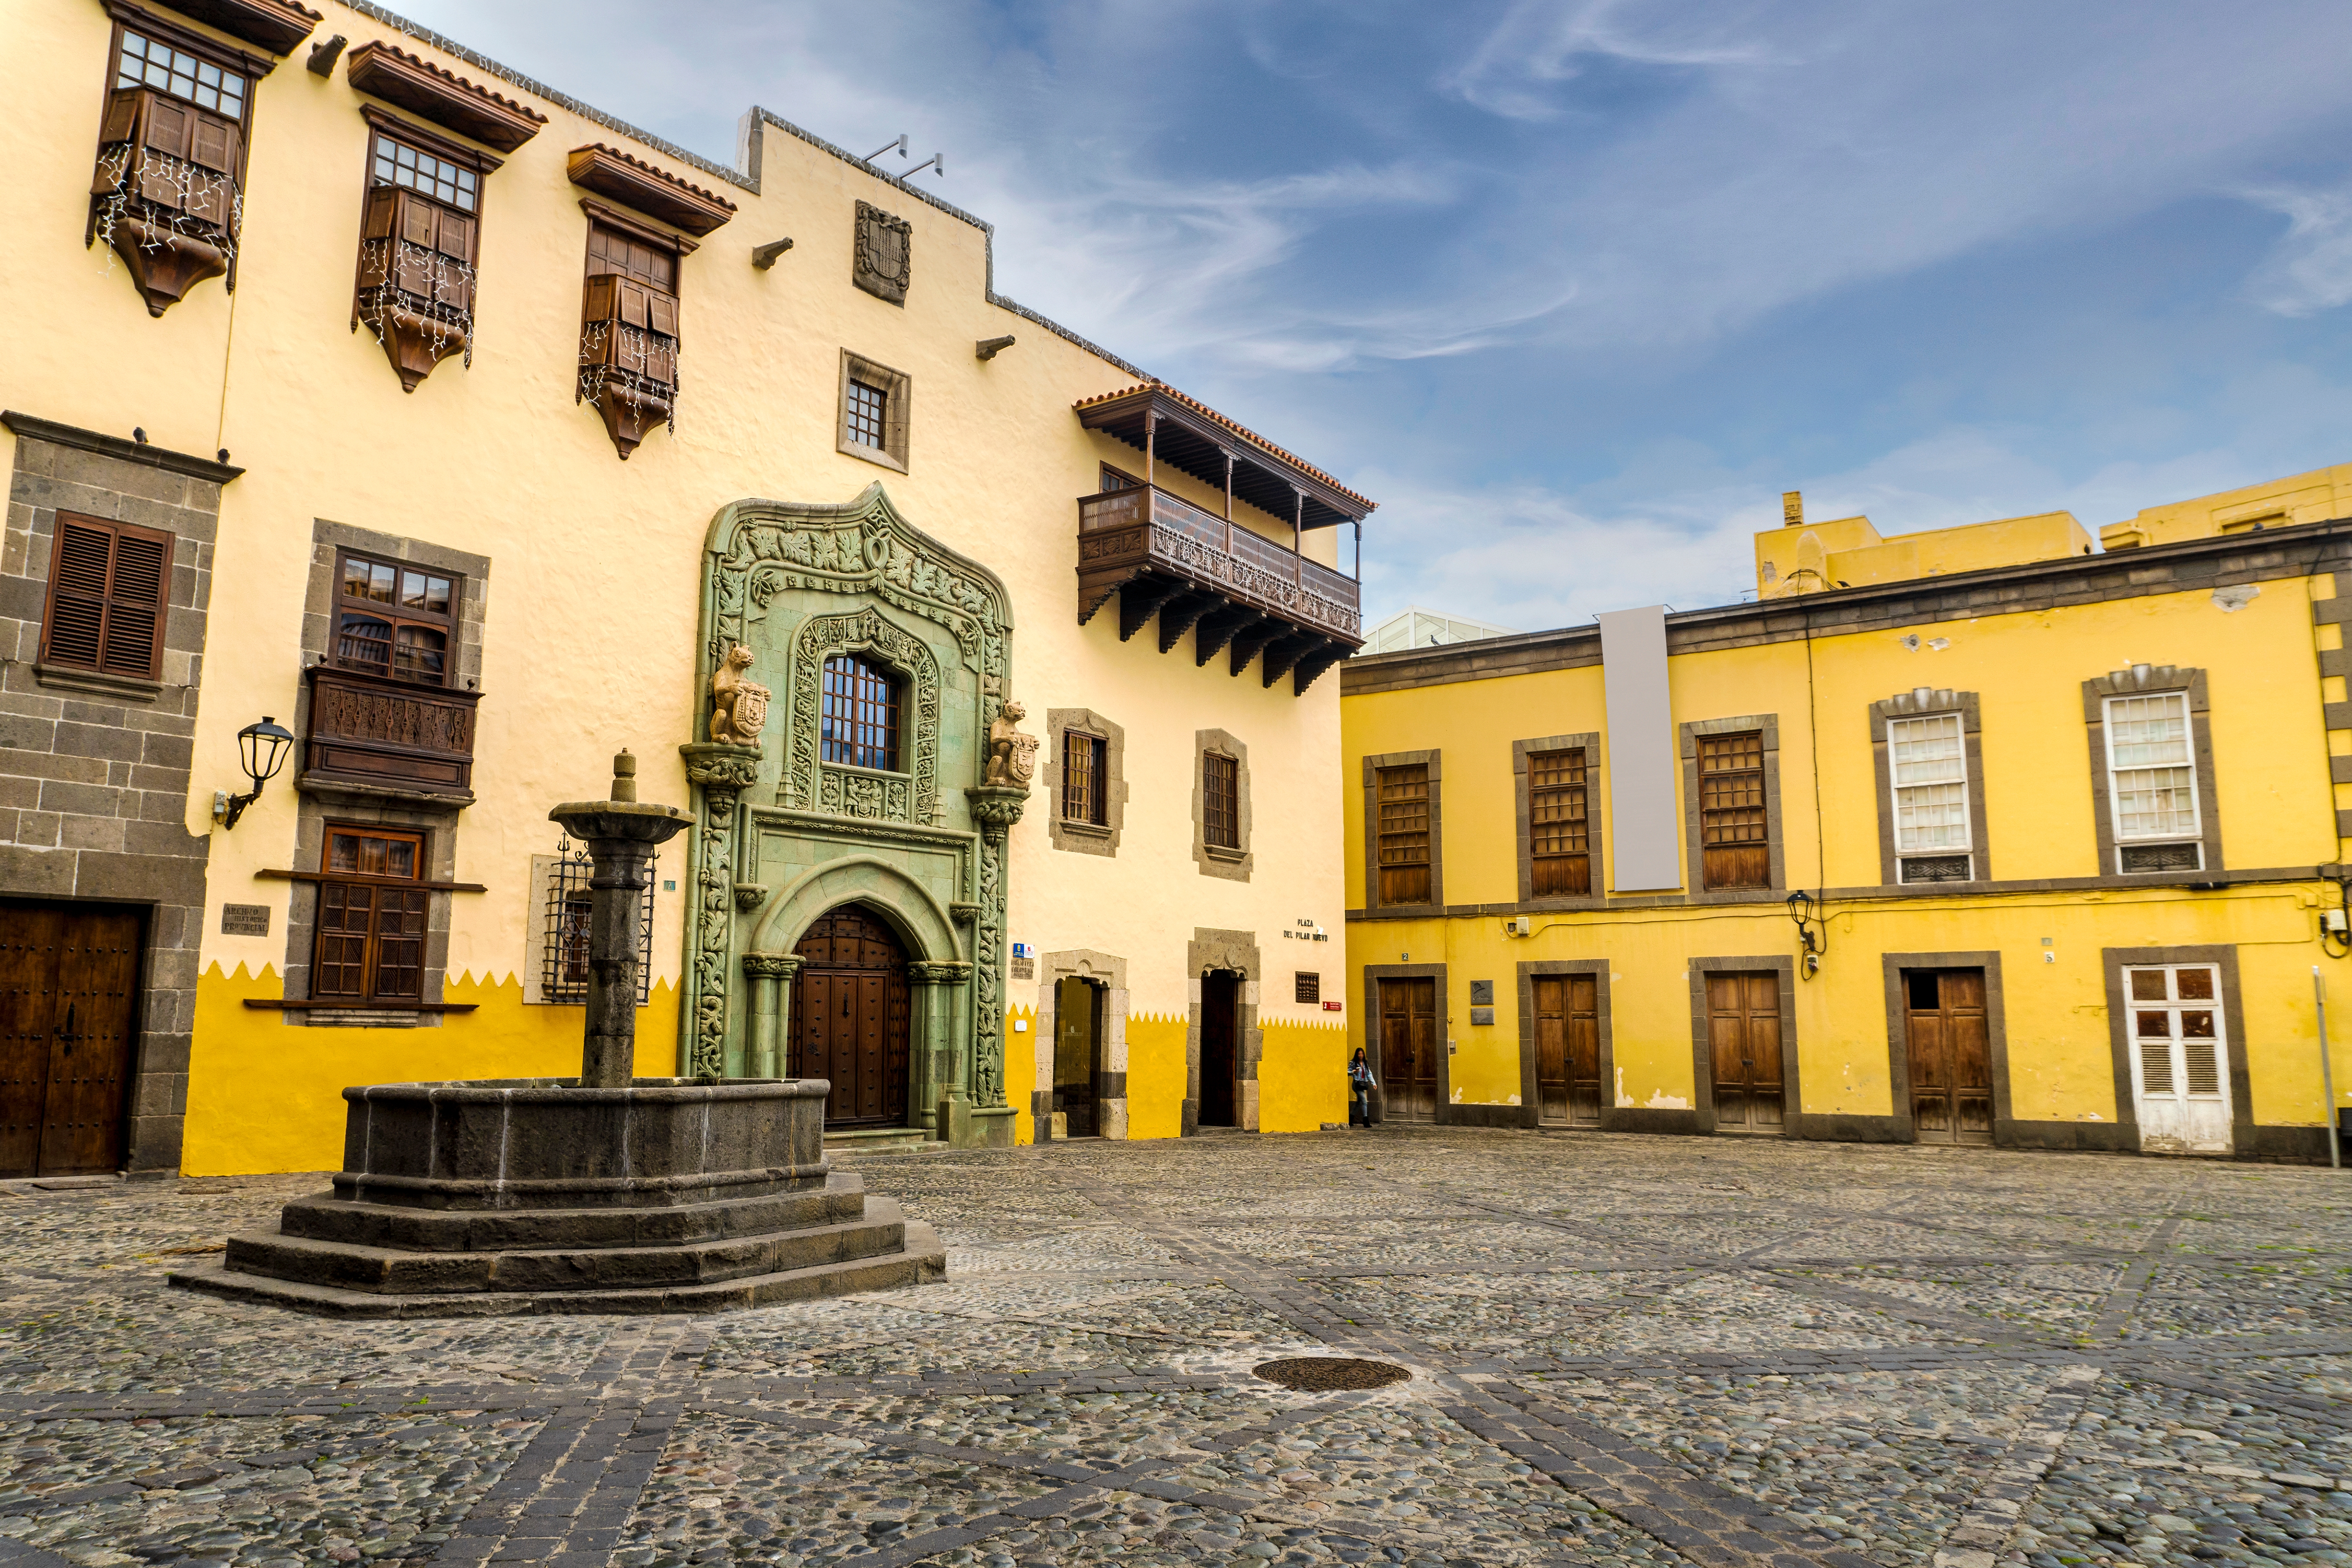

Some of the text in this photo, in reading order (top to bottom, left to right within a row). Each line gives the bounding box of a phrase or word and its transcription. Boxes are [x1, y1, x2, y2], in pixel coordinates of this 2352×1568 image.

[668, 881, 671, 890] 2
[224, 907, 258, 916] ARCHIVO
[224, 923, 268, 932] PROVINCIAL
[1297, 919, 1313, 927] PLAZA
[1284, 930, 1328, 942] DEL PILAR NUEVO
